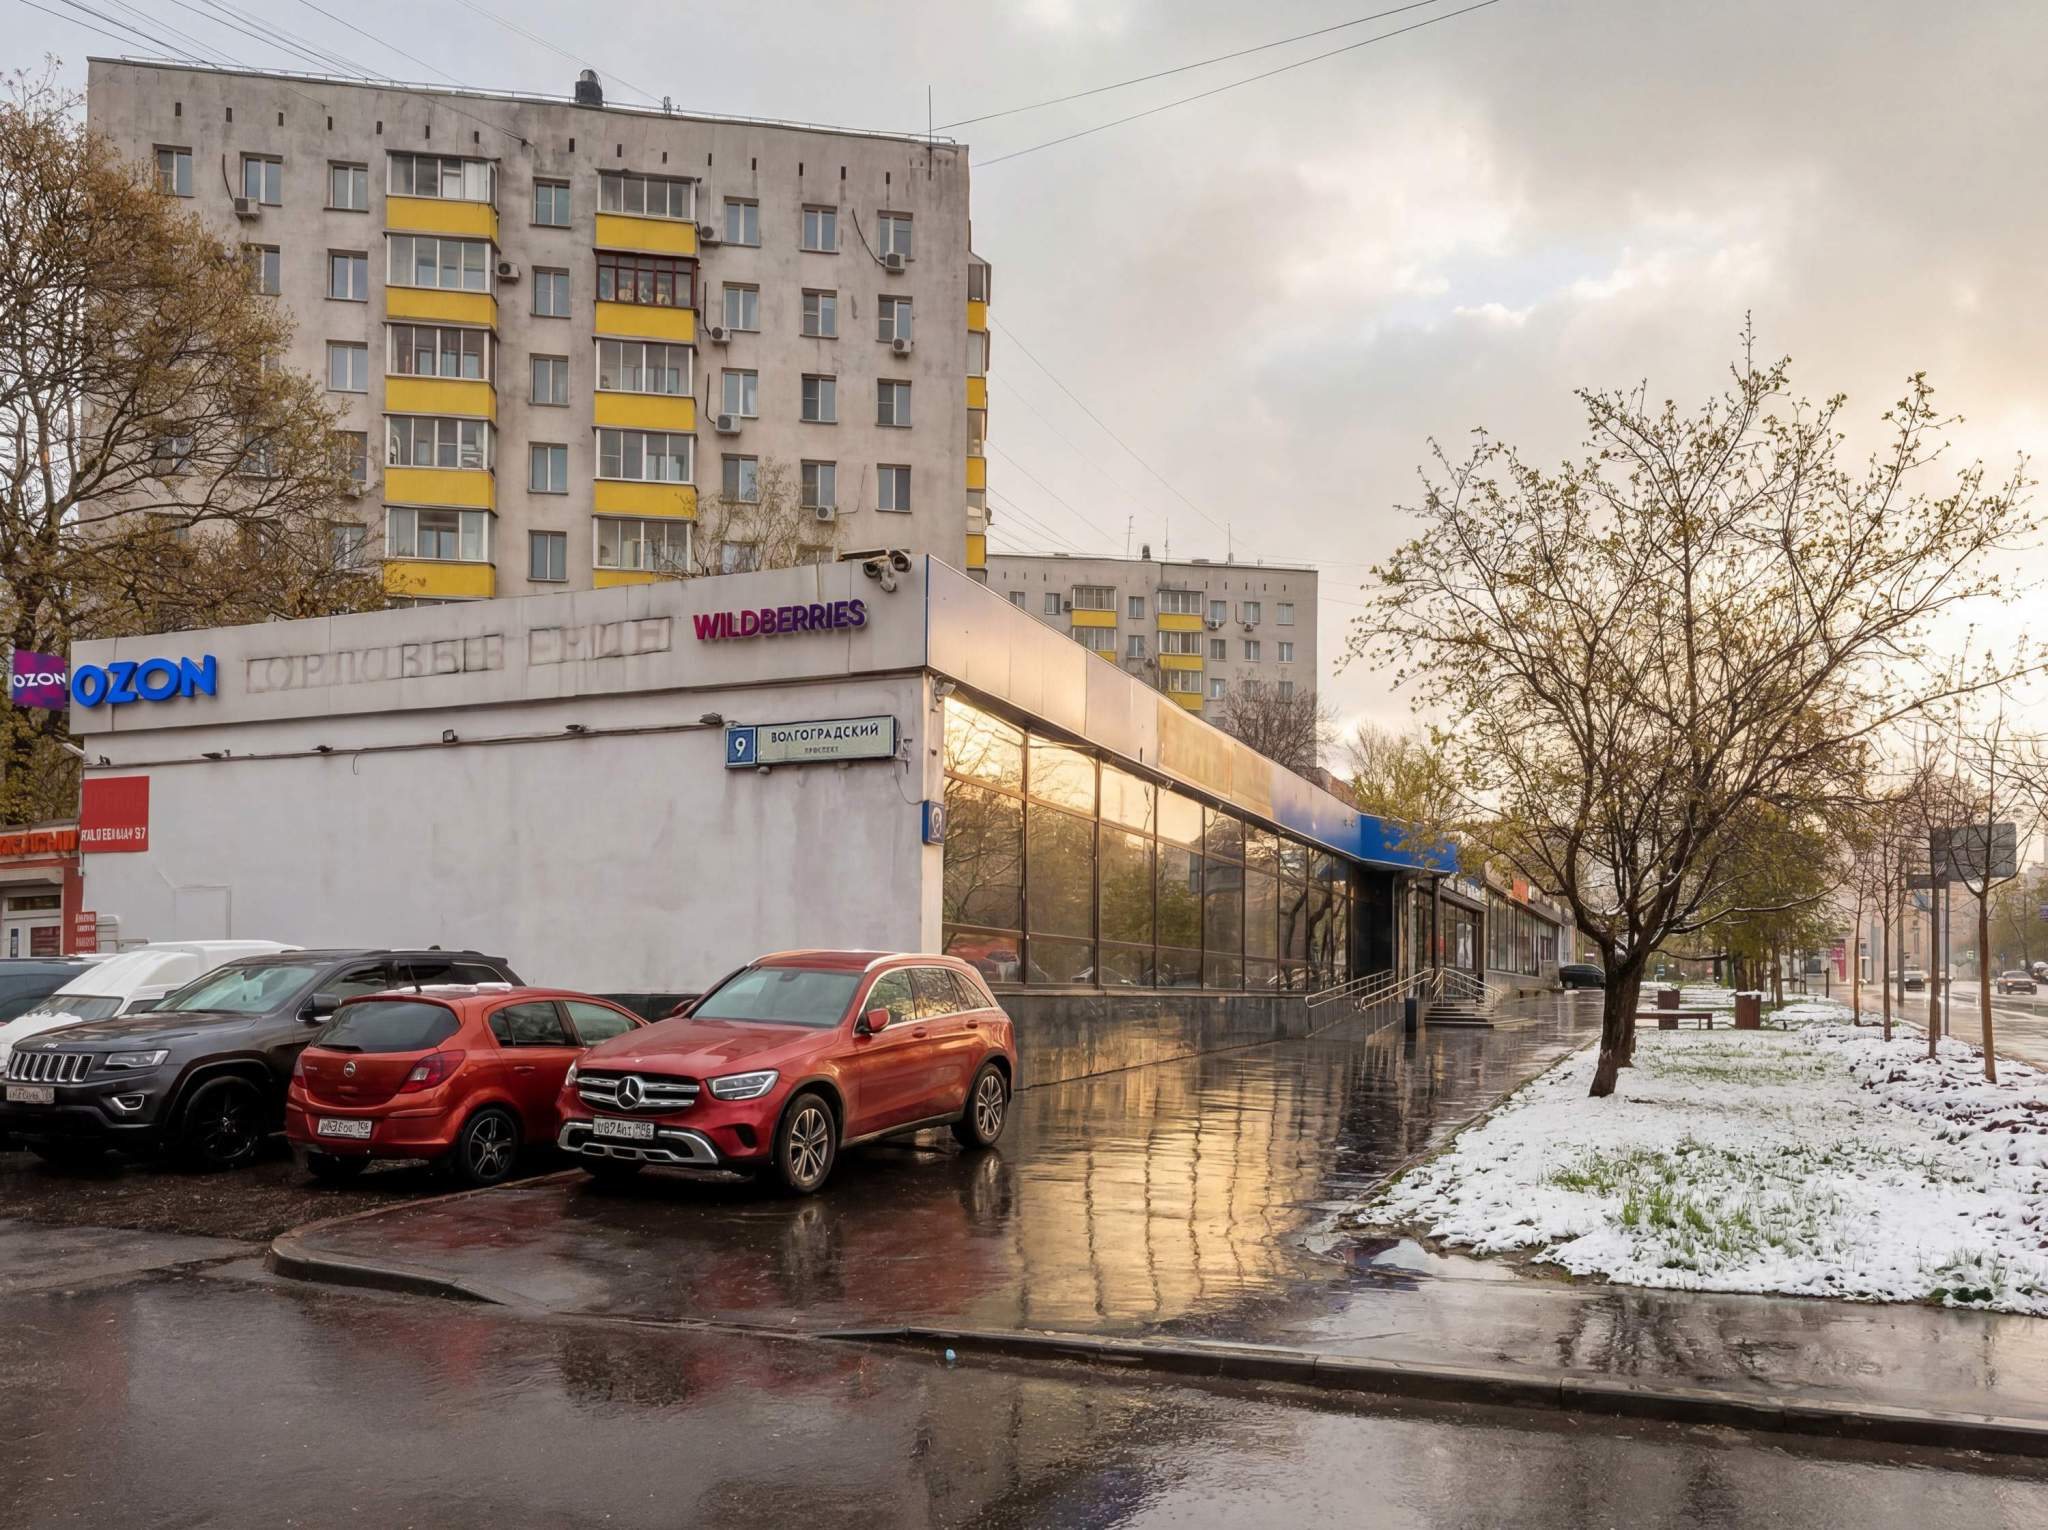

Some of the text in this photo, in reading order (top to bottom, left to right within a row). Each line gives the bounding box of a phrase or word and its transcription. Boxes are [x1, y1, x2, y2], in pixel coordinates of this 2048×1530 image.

[693, 599, 866, 640] WILDBERRIES
[13, 672, 66, 688] OZON
[71, 654, 217, 708] OZON
[771, 722, 879, 743] ВОЛГОГРАДСКИЙ
[735, 737, 747, 757] 9
[804, 746, 839, 754] ПРОСПЕКТ
